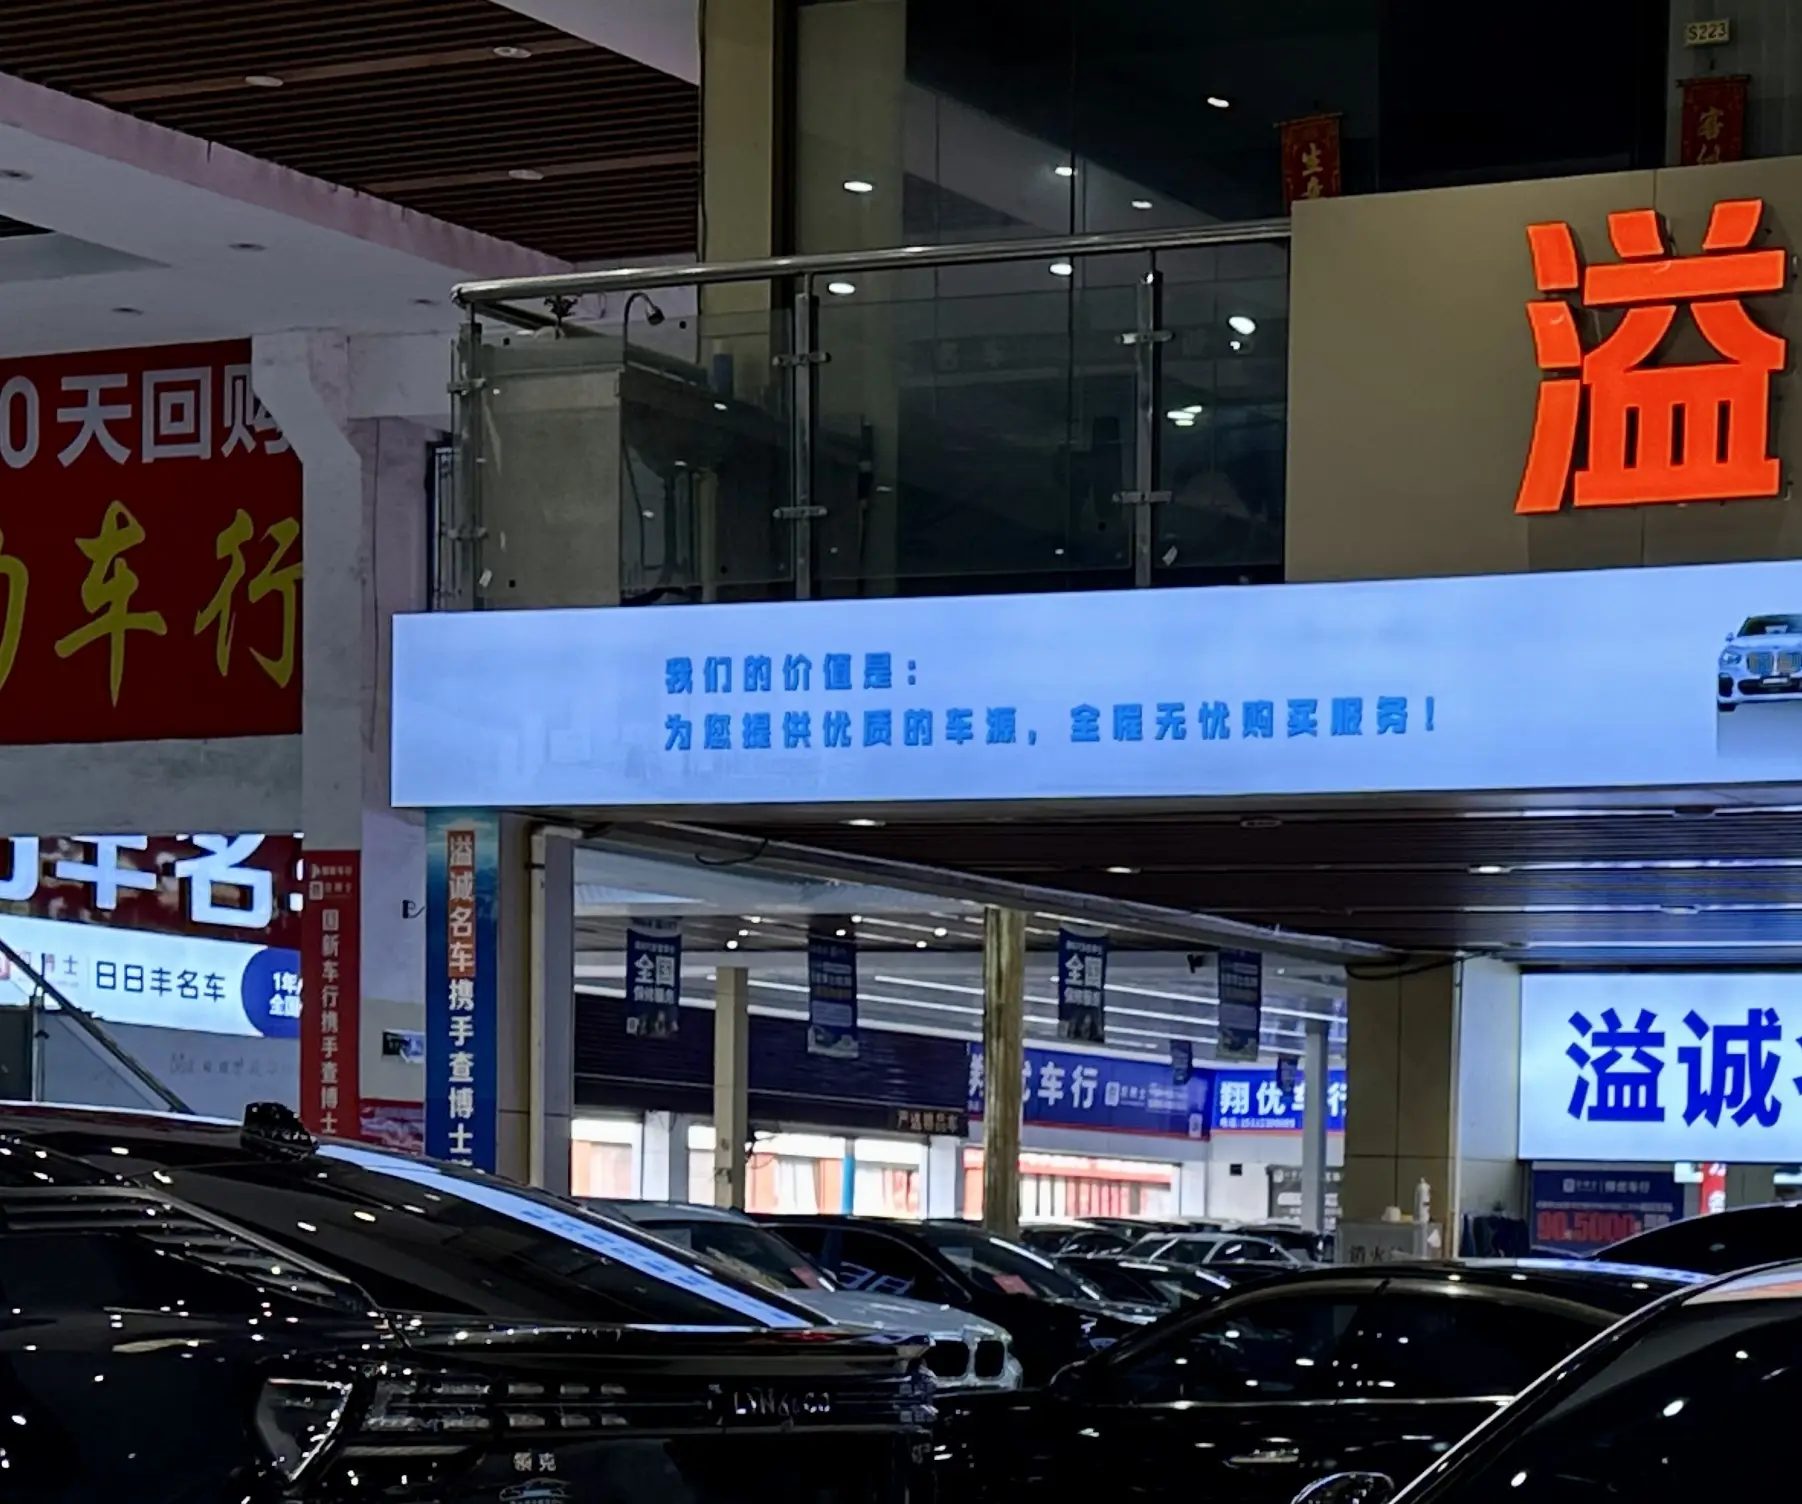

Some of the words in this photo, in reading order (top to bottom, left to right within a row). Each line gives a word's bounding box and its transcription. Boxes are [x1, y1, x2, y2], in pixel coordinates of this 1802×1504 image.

[1688, 23, 1727, 41] S223
[95, 960, 227, 1002] 日日丰名车
[447, 832, 476, 1166] 溢诚名车携手查博士
